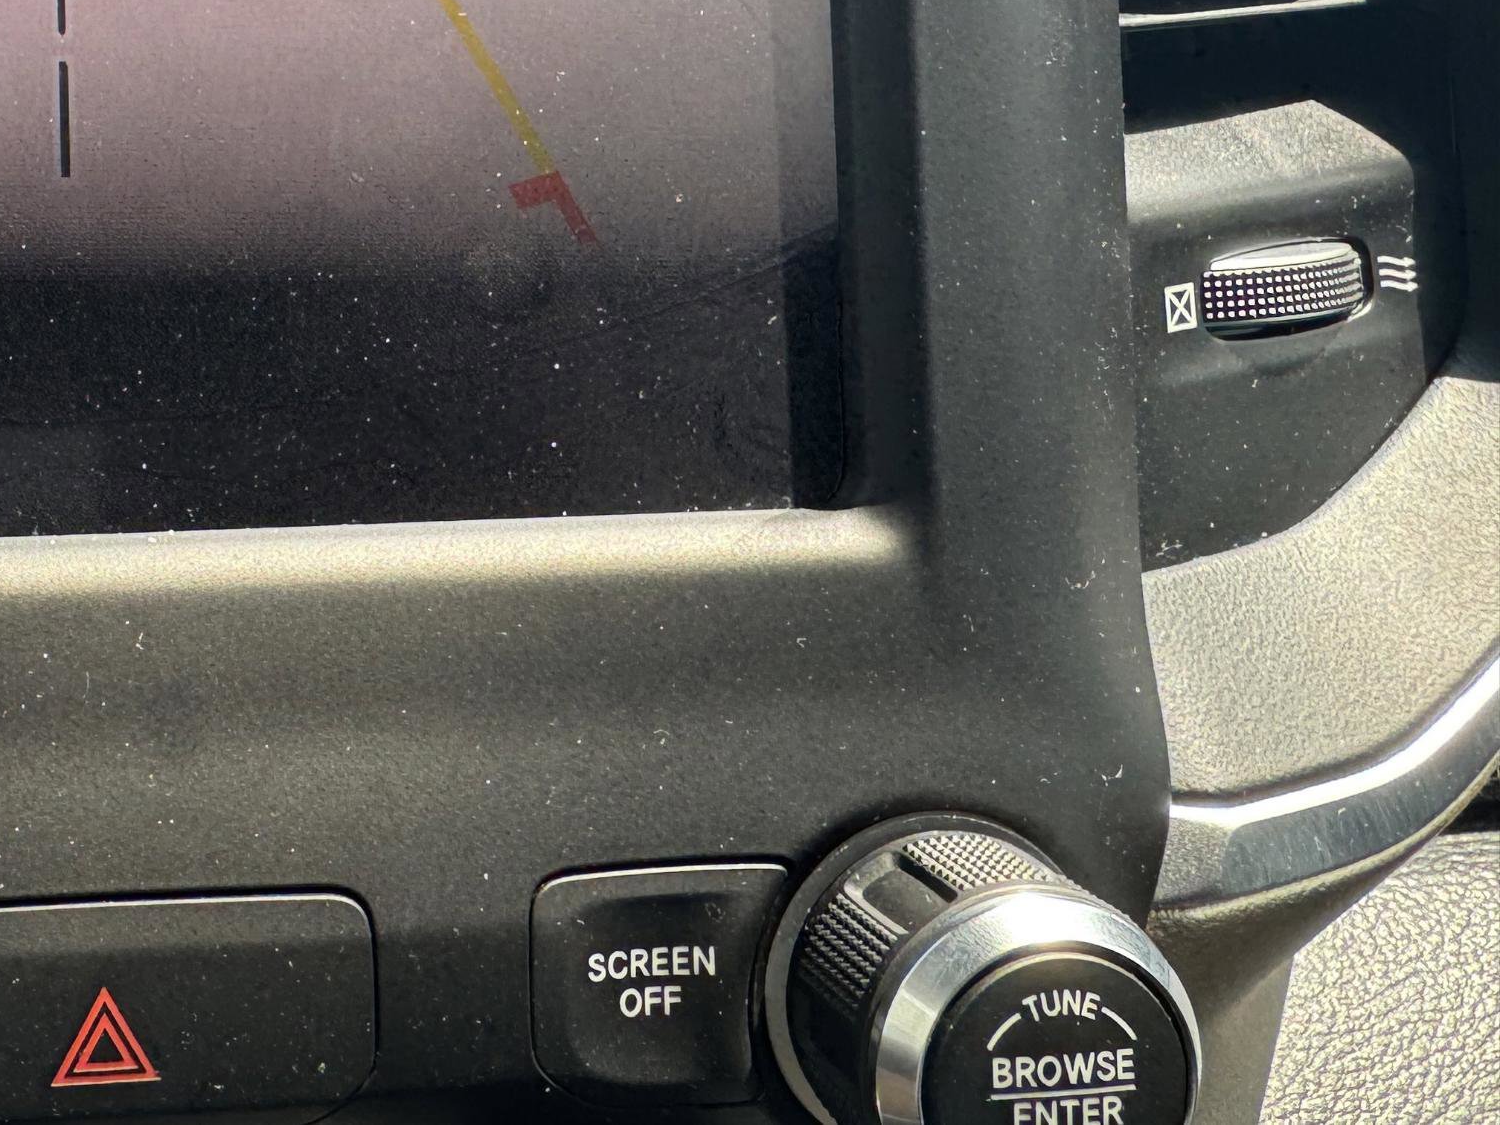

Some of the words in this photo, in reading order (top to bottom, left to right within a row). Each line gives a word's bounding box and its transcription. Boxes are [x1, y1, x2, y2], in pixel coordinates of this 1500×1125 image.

[588, 945, 716, 983] SCREEN
[619, 985, 682, 1018] OFF
[1021, 989, 1101, 1022] TUNE
[992, 1048, 1136, 1089] BROWSE
[1013, 1095, 1124, 1125] ENTER
